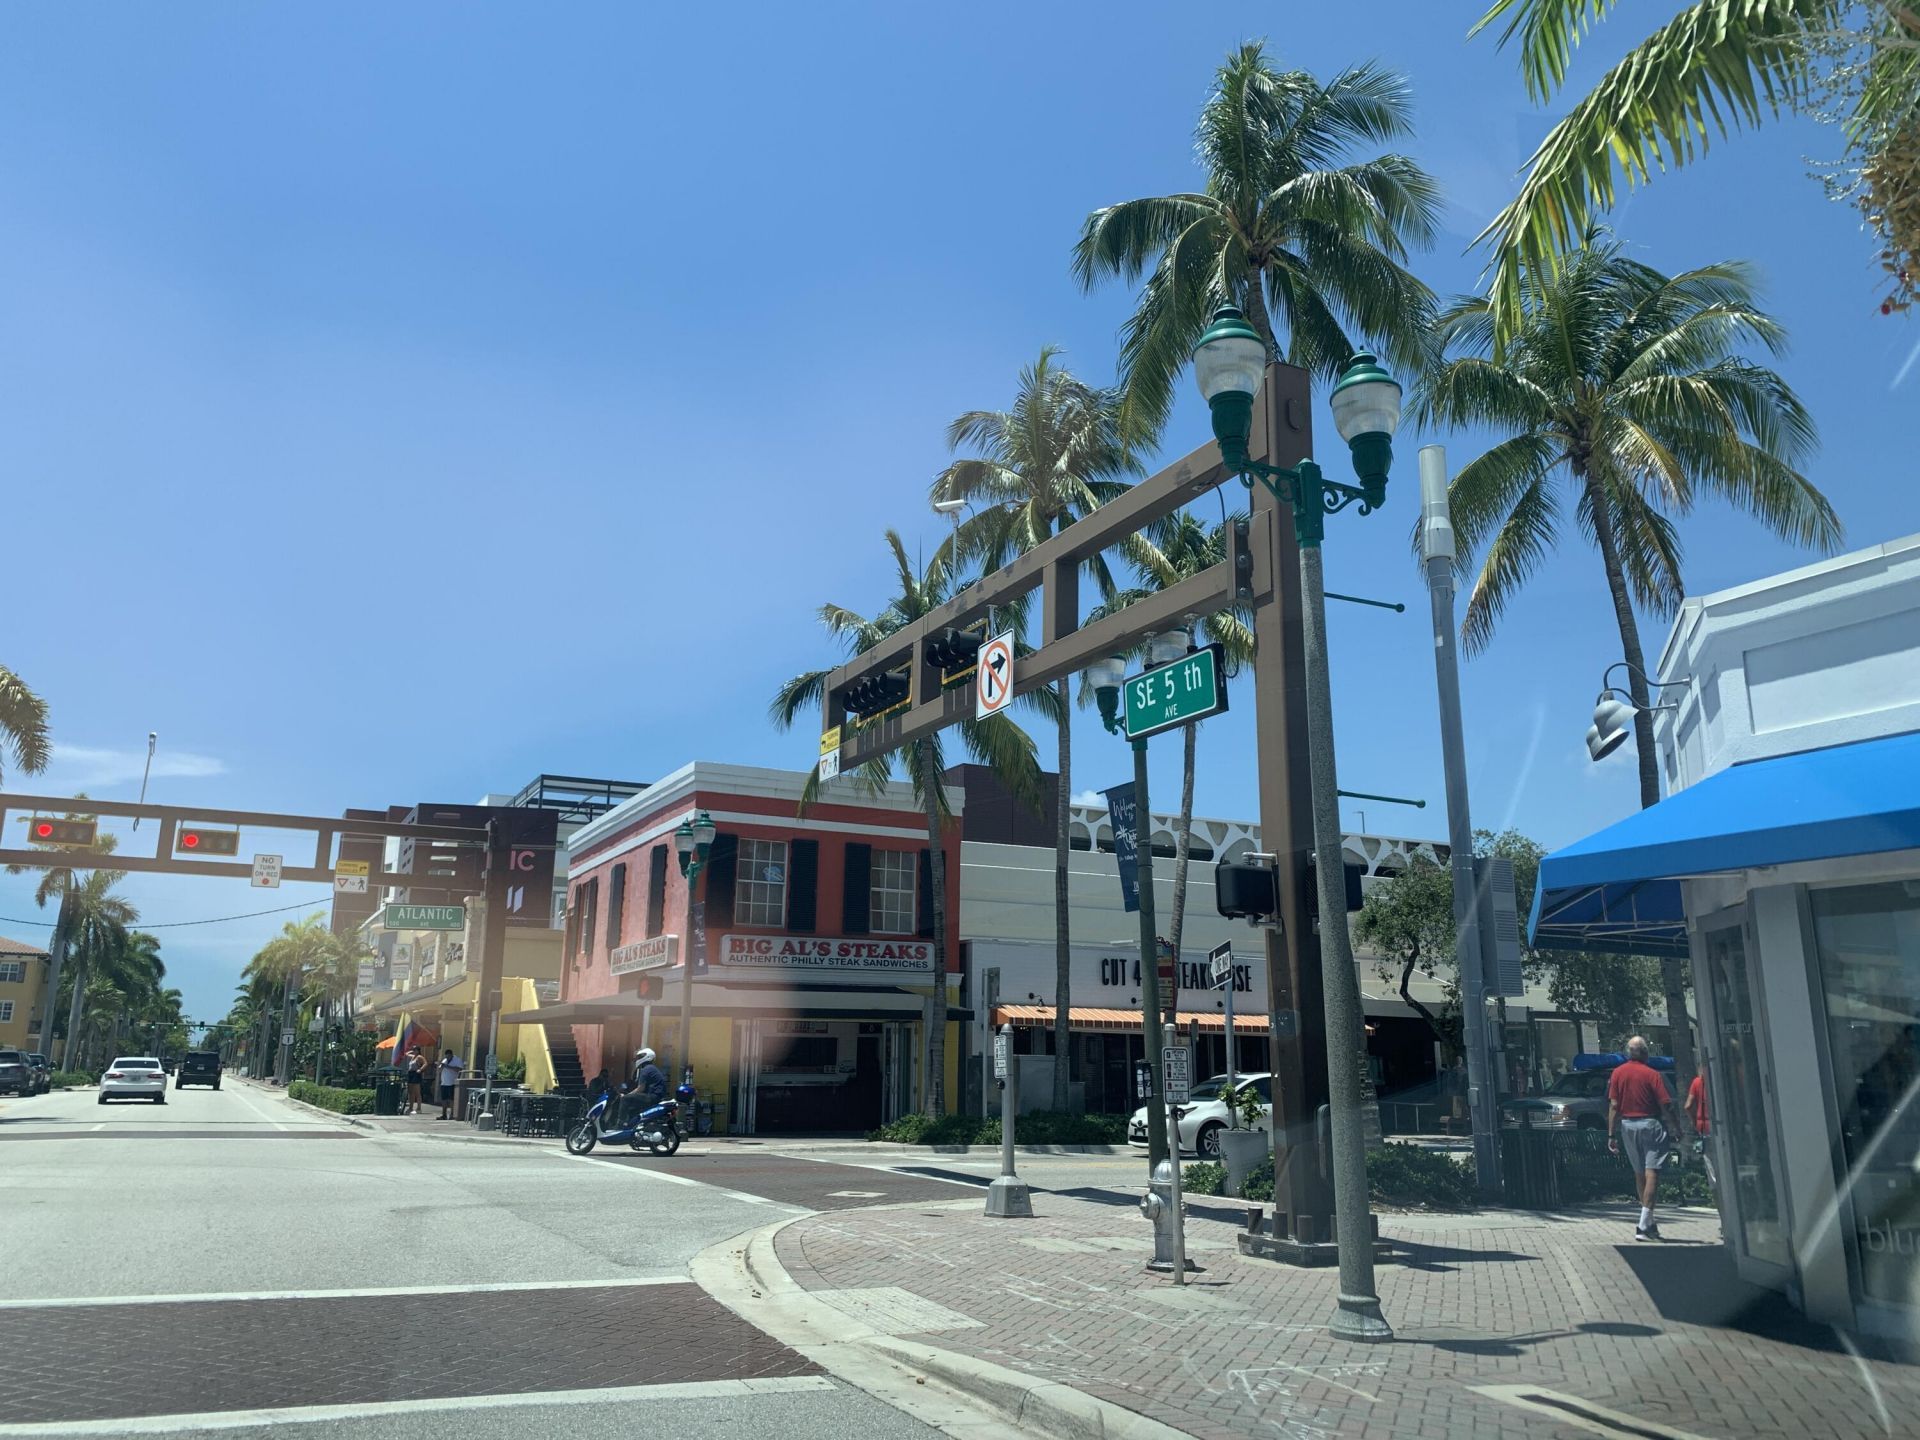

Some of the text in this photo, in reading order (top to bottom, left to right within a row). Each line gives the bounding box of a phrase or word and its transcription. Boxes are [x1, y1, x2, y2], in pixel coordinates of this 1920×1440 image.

[1136, 661, 1202, 710] SE 5 th
[1164, 703, 1178, 719] AVE
[398, 907, 453, 920] ATLANTIC
[638, 938, 666, 960] STEAKS
[730, 938, 928, 960] BIG AL'S STEAKS
[728, 954, 929, 969] AUTHENTIC PHILLY STEAK SANDWICHES
[1101, 958, 1127, 987] CUT
[1864, 1215, 1920, 1254] blu
